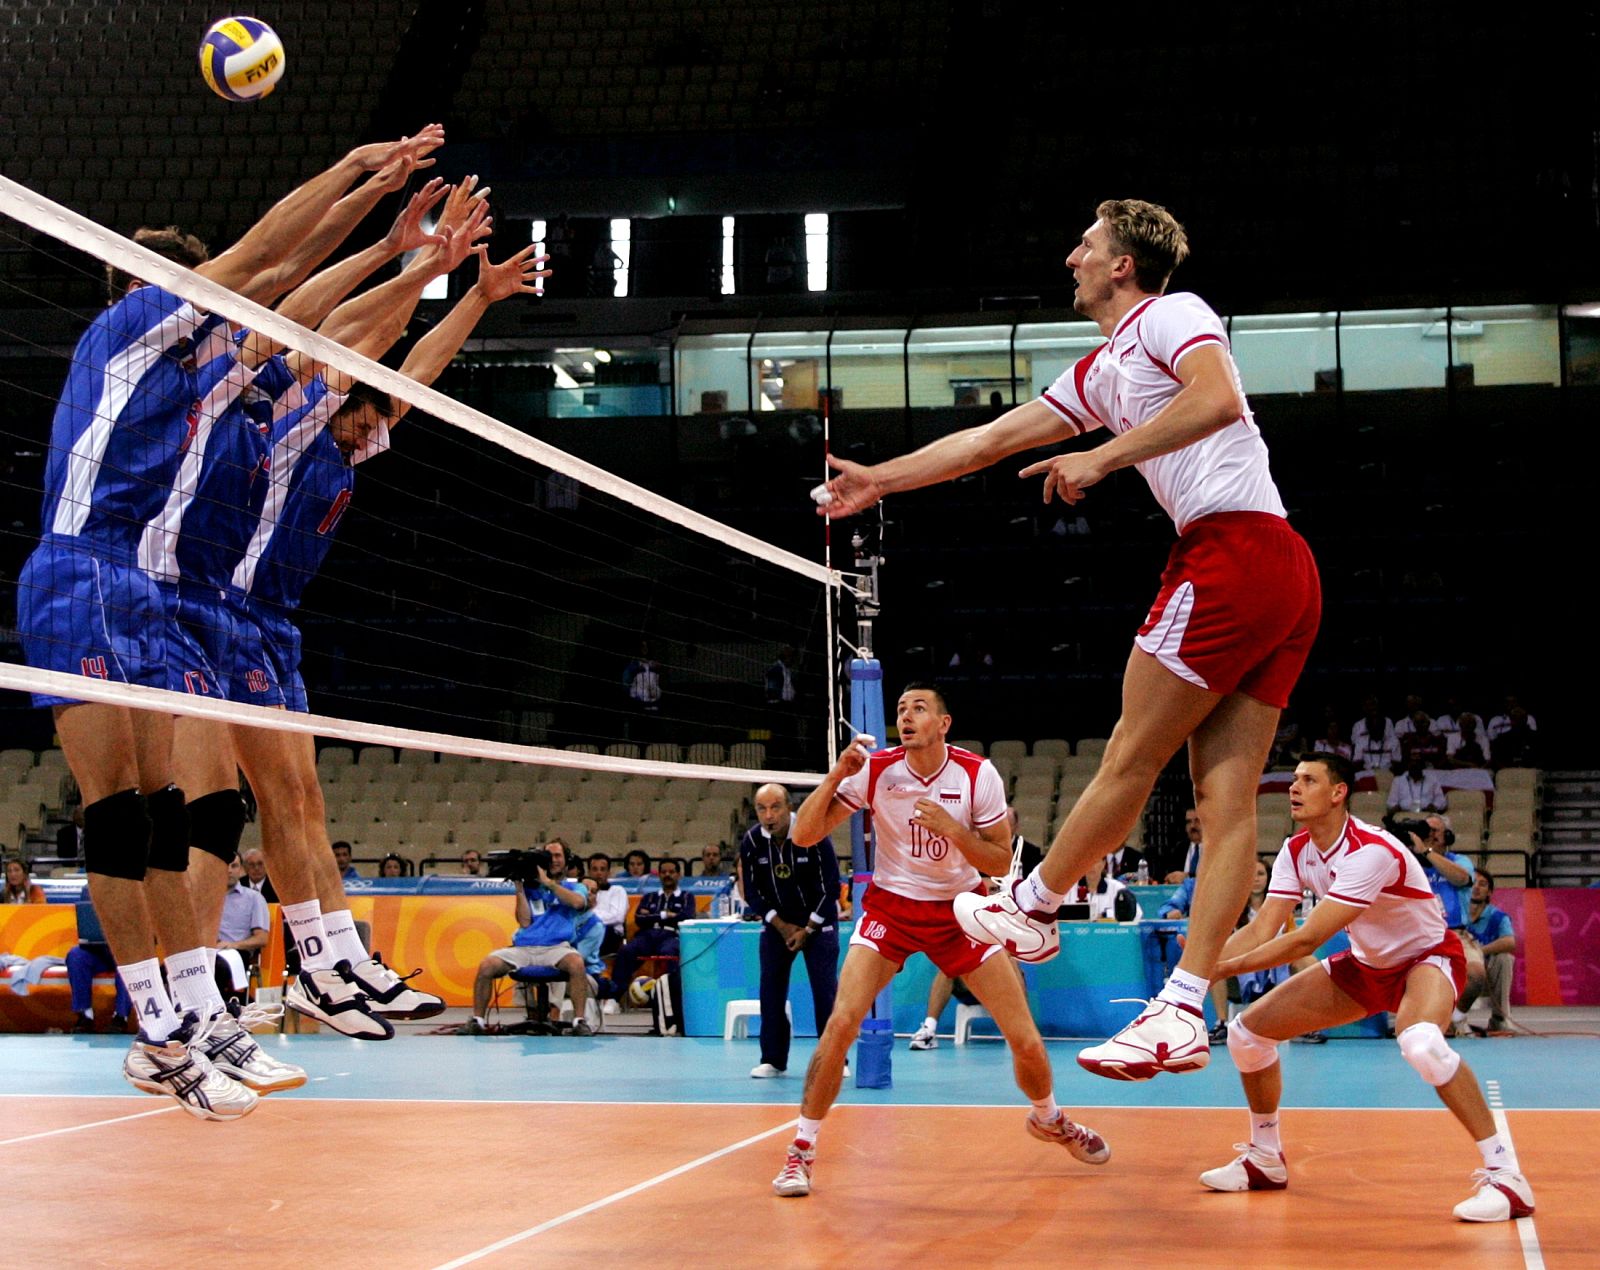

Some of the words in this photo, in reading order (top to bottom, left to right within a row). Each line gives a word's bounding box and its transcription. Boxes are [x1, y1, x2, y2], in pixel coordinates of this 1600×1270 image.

[244, 53, 277, 83] FIVB
[81, 656, 108, 680] 14
[184, 671, 208, 694] 17
[245, 669, 269, 692] 10
[908, 818, 949, 861] 18
[863, 920, 887, 939] 18
[297, 936, 323, 960] 10
